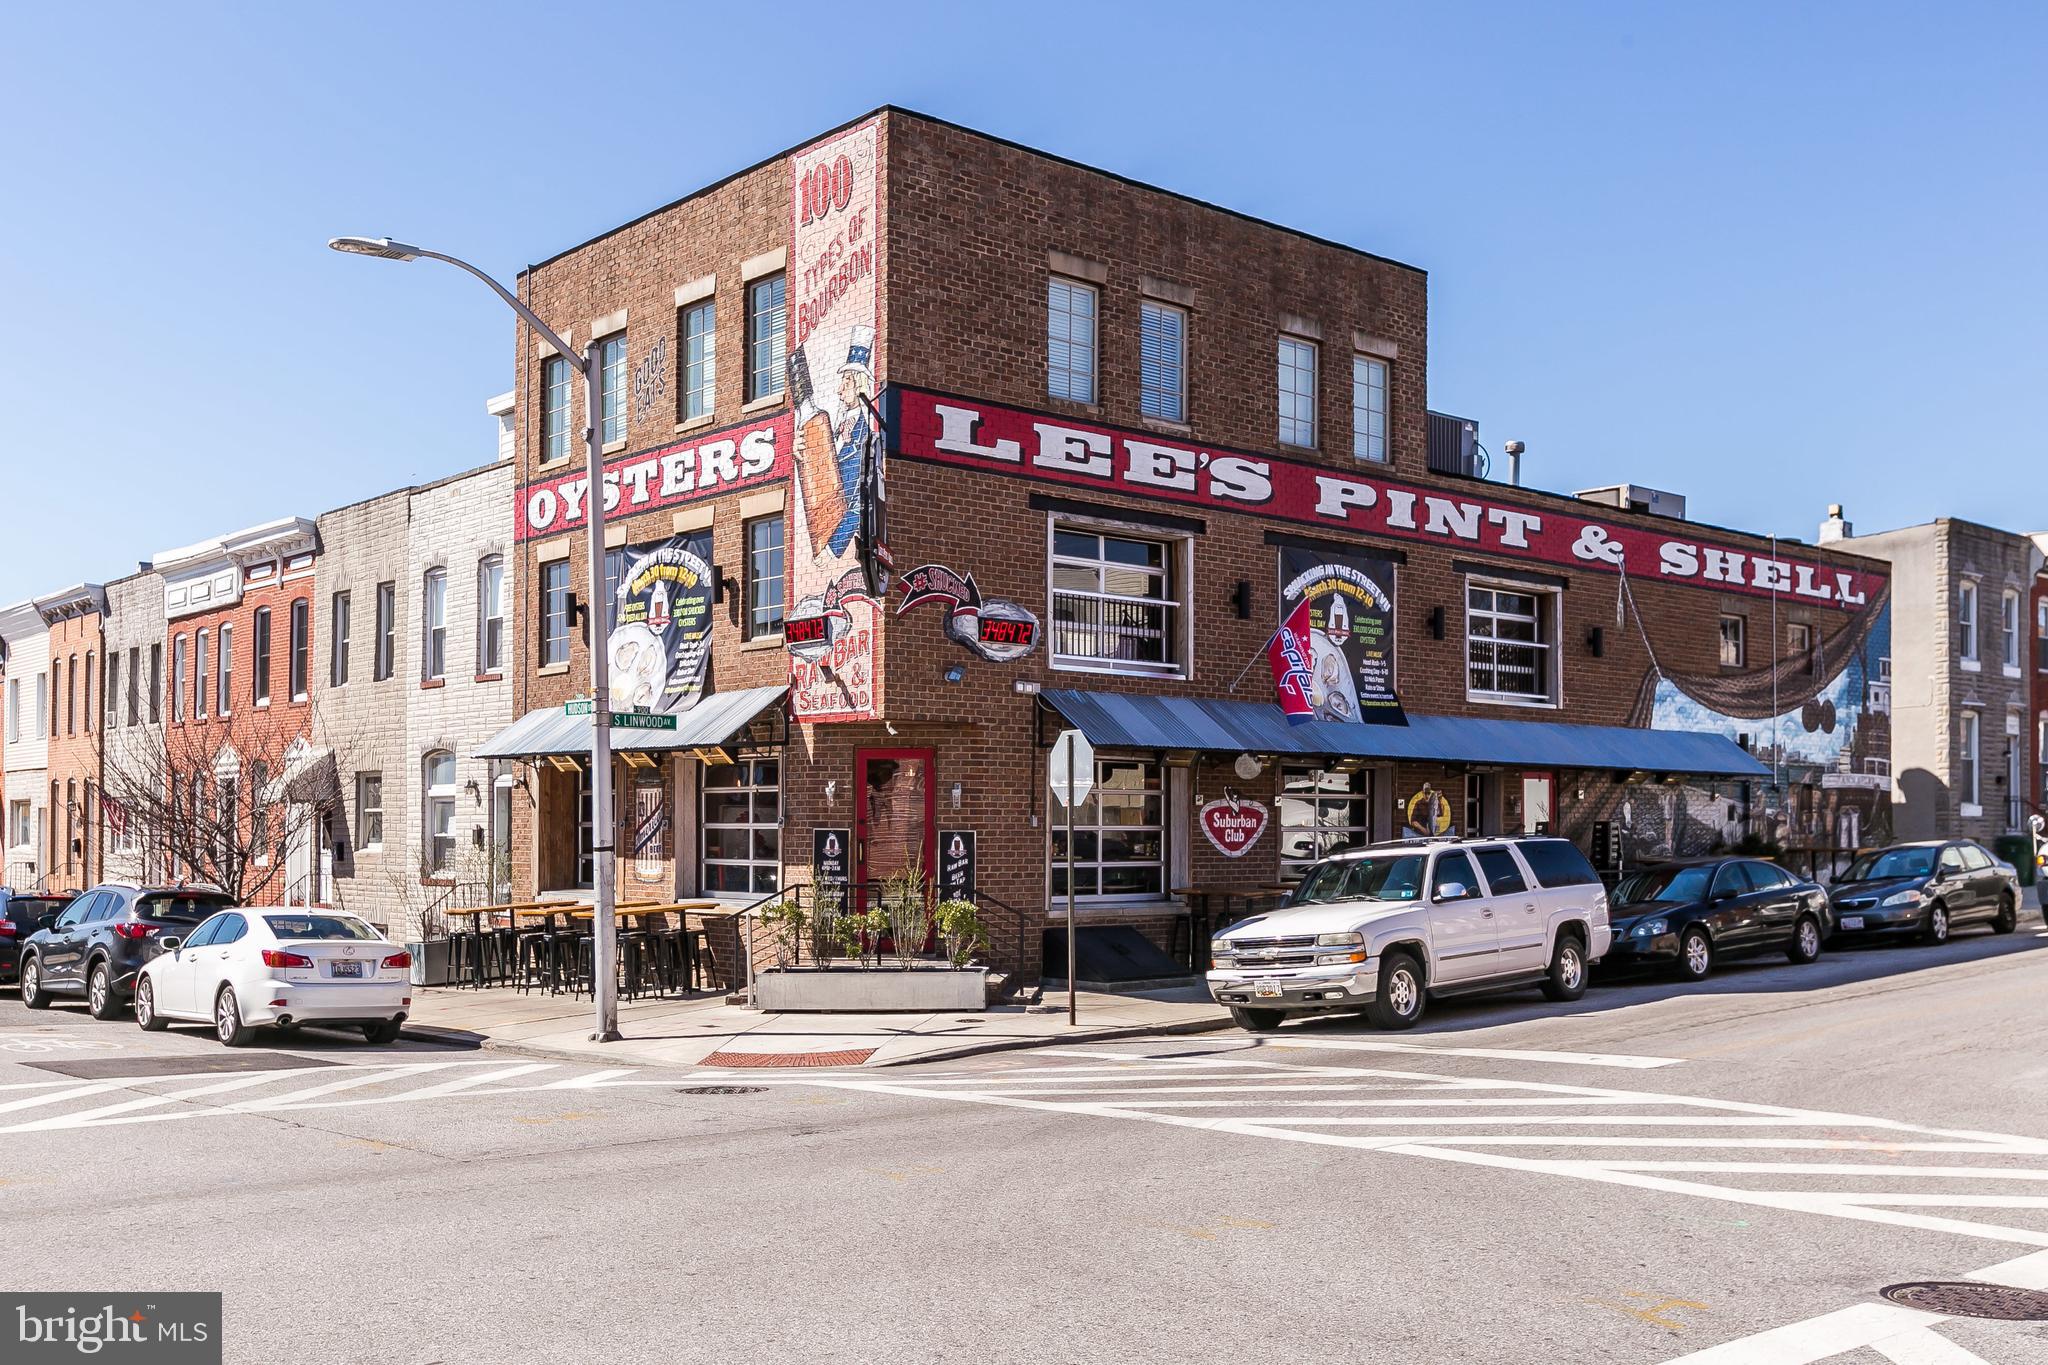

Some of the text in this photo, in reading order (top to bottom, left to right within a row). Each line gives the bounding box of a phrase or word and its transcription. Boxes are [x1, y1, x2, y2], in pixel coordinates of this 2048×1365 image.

[799, 154, 854, 227] 100
[804, 208, 867, 294] TYPES OF
[798, 240, 873, 343] BOURBON
[635, 335, 666, 395] GOOD
[527, 427, 776, 531] OYSTERS
[934, 404, 1865, 605] LEE'S PINT & SHELL
[912, 567, 971, 602] # SHUCKED
[1327, 579, 1337, 592] 30
[1337, 579, 1356, 594] from
[1355, 585, 1375, 608] 12-10
[1334, 564, 1351, 580] THE
[1351, 569, 1381, 598] STREET
[785, 618, 824, 644] 348472
[980, 620, 1033, 644] 348472
[833, 629, 870, 671] BAR
[851, 662, 867, 688] &
[567, 703, 588, 715] HUDSON
[799, 690, 870, 711] SEAFOOD
[624, 716, 664, 729] LINWOOD
[1213, 812, 1257, 828] Suburban
[1224, 829, 1245, 843] Club
[957, 858, 969, 867] BAR
